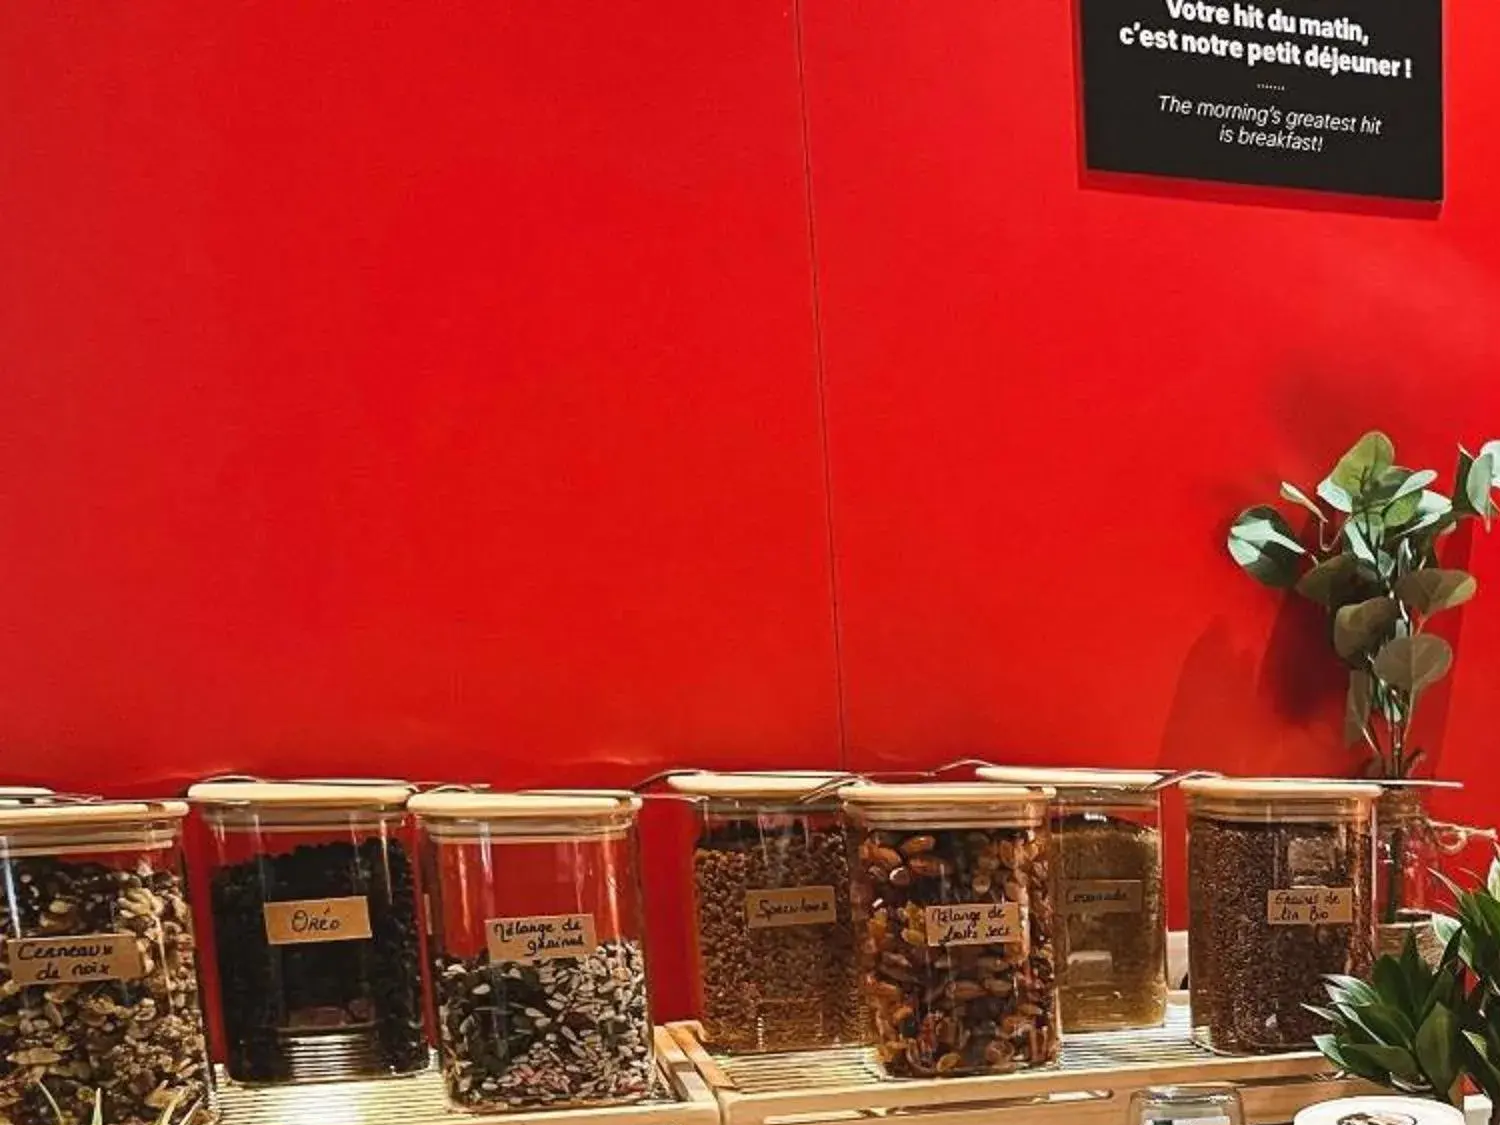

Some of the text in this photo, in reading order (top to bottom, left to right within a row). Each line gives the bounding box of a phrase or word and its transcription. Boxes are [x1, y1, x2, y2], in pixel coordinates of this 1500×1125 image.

[1165, 0, 1370, 47] Votre hit du matin,
[1119, 21, 1179, 51] c'est
[1181, 33, 1244, 59] notre
[1246, 41, 1302, 66] petit
[1303, 46, 1401, 78] déjeuner
[1158, 95, 1383, 135] The morning's greatest hit
[1218, 124, 1324, 152] is breakfast!
[35, 961, 61, 981] de
